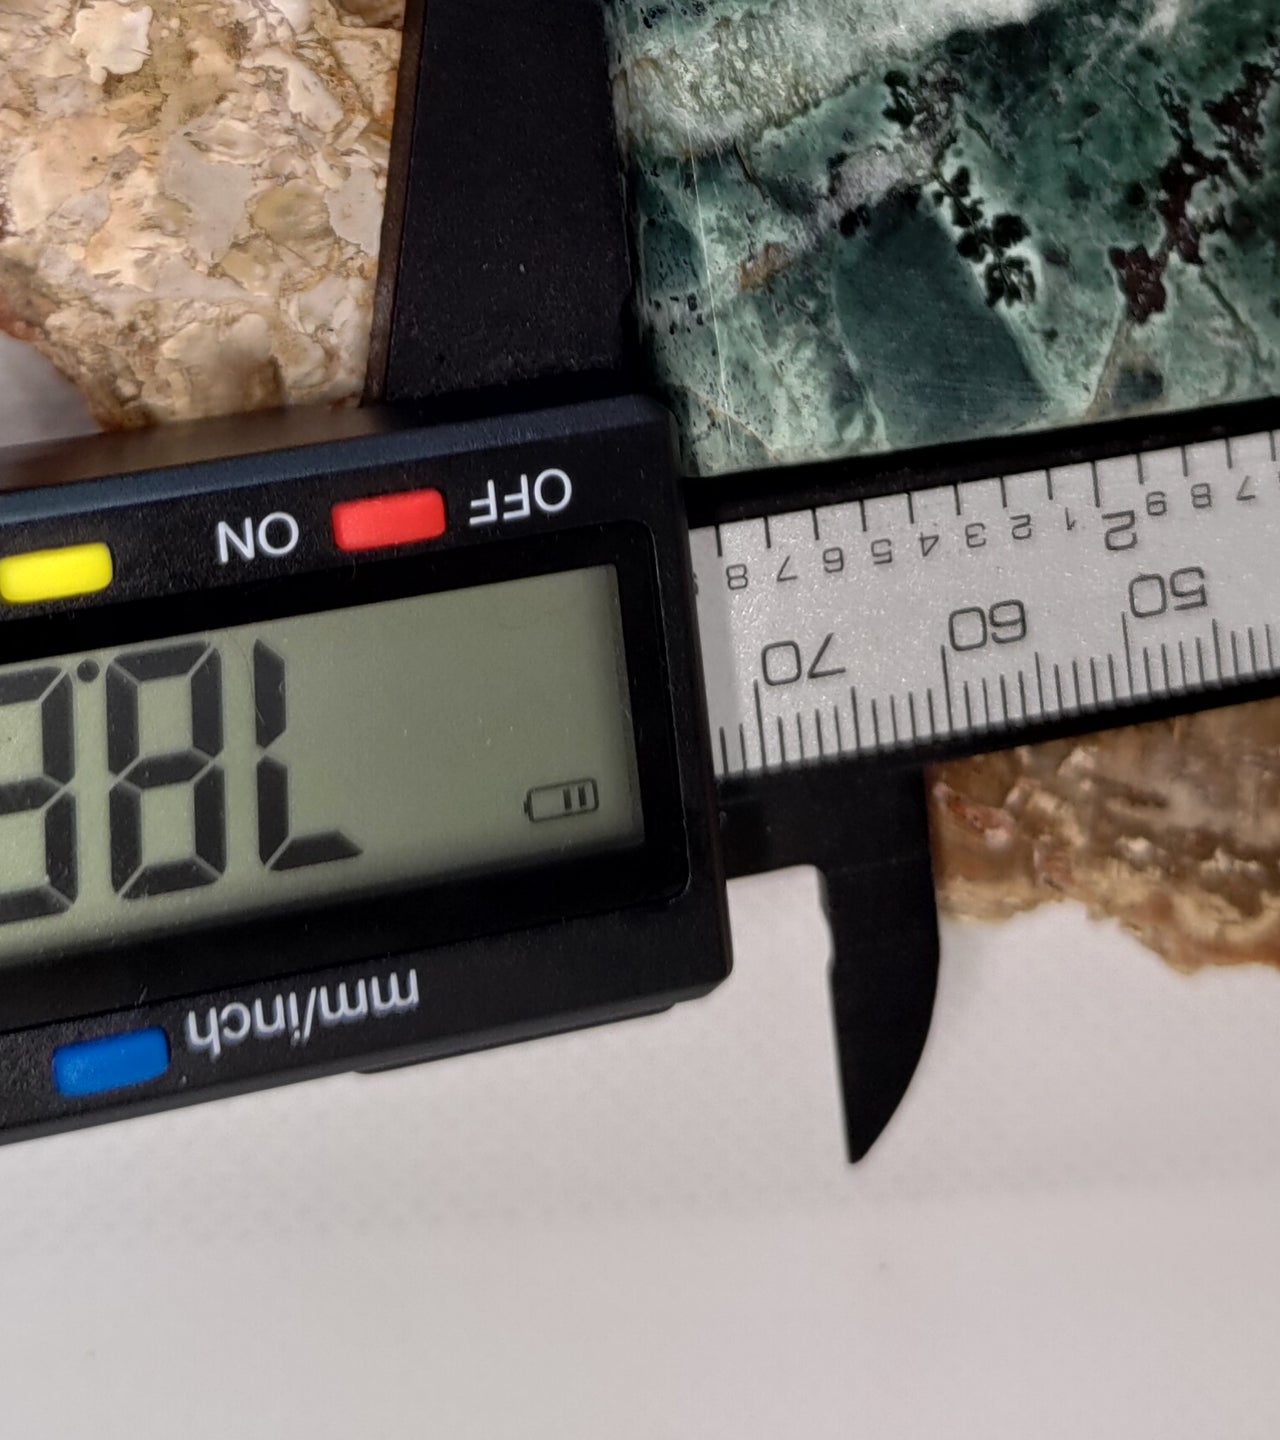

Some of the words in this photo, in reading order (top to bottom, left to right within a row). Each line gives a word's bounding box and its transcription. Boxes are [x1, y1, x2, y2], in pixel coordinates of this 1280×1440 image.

[469, 468, 572, 527] OFF
[1191, 483, 1213, 507] 8
[1236, 476, 1256, 501] 7
[1146, 491, 1168, 516] 9
[1011, 514, 1032, 539] 2
[1065, 508, 1077, 531] 1
[1102, 510, 1137, 551] 2
[216, 512, 298, 562] ON
[919, 531, 940, 558] 4
[965, 522, 987, 547] 3
[823, 547, 844, 572] 6
[871, 539, 893, 564] 5
[726, 564, 749, 589] 8
[776, 556, 797, 581] 7
[1129, 567, 1207, 618] 50
[948, 599, 1026, 651] 60
[761, 633, 846, 686] 70
[186, 969, 420, 1056] mm/inch
